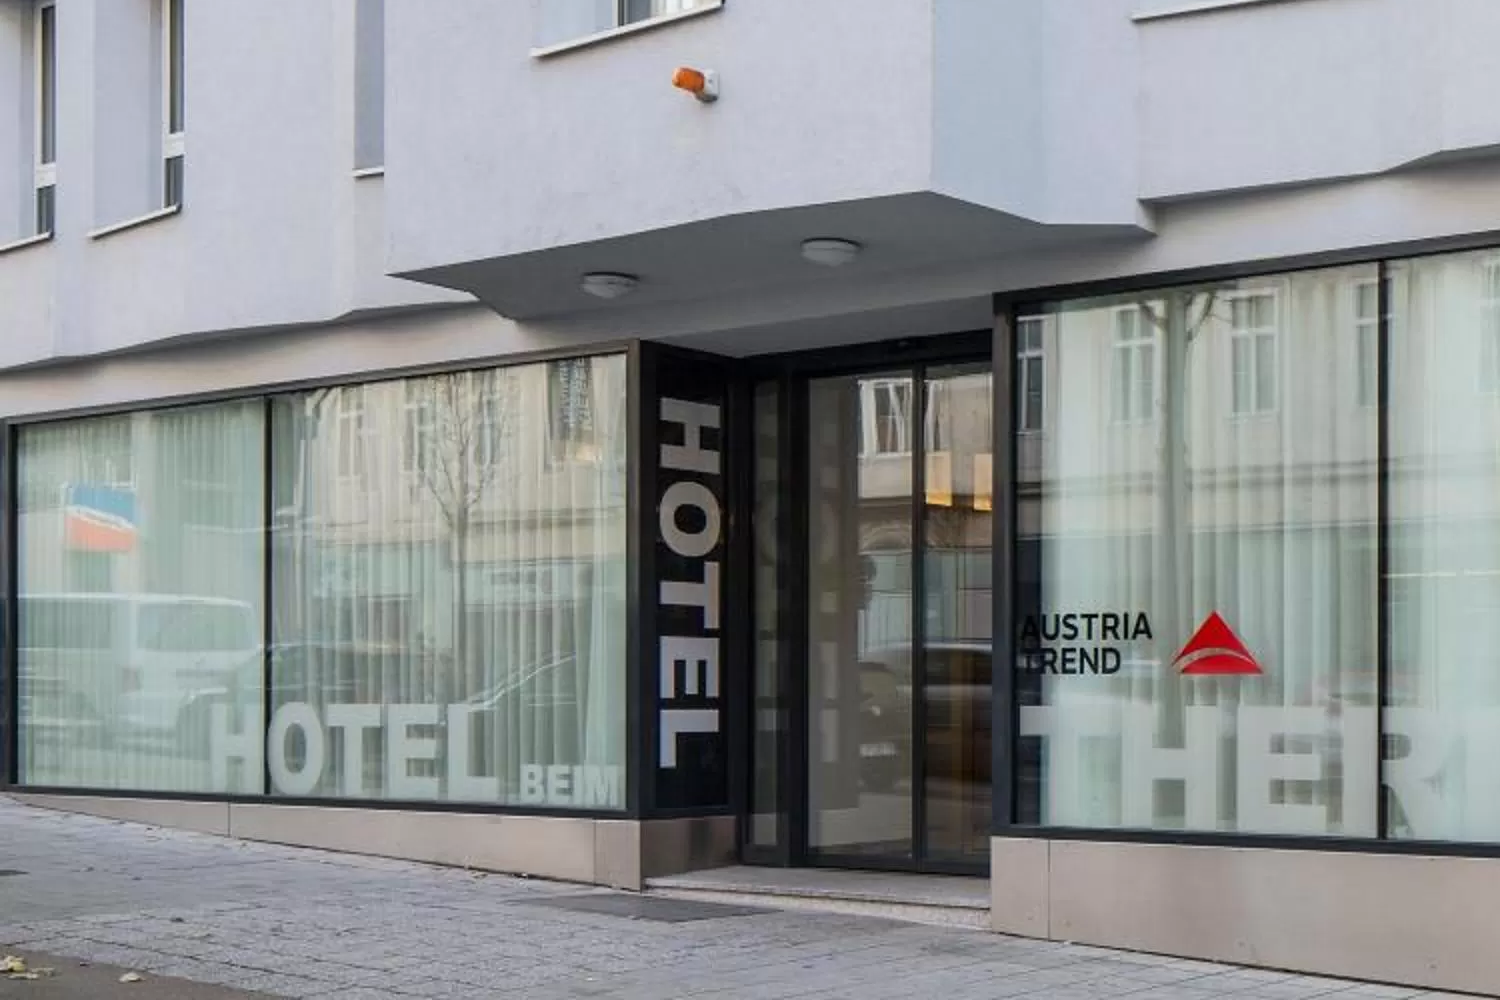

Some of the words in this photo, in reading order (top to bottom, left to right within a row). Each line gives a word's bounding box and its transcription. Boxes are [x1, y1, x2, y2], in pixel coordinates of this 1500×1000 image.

[660, 398, 720, 769] HOTEL
[1021, 613, 1153, 641] AUSTRIA
[1022, 648, 1122, 674] TREND
[211, 702, 497, 799] HOTEL
[520, 764, 620, 806] BEIM
